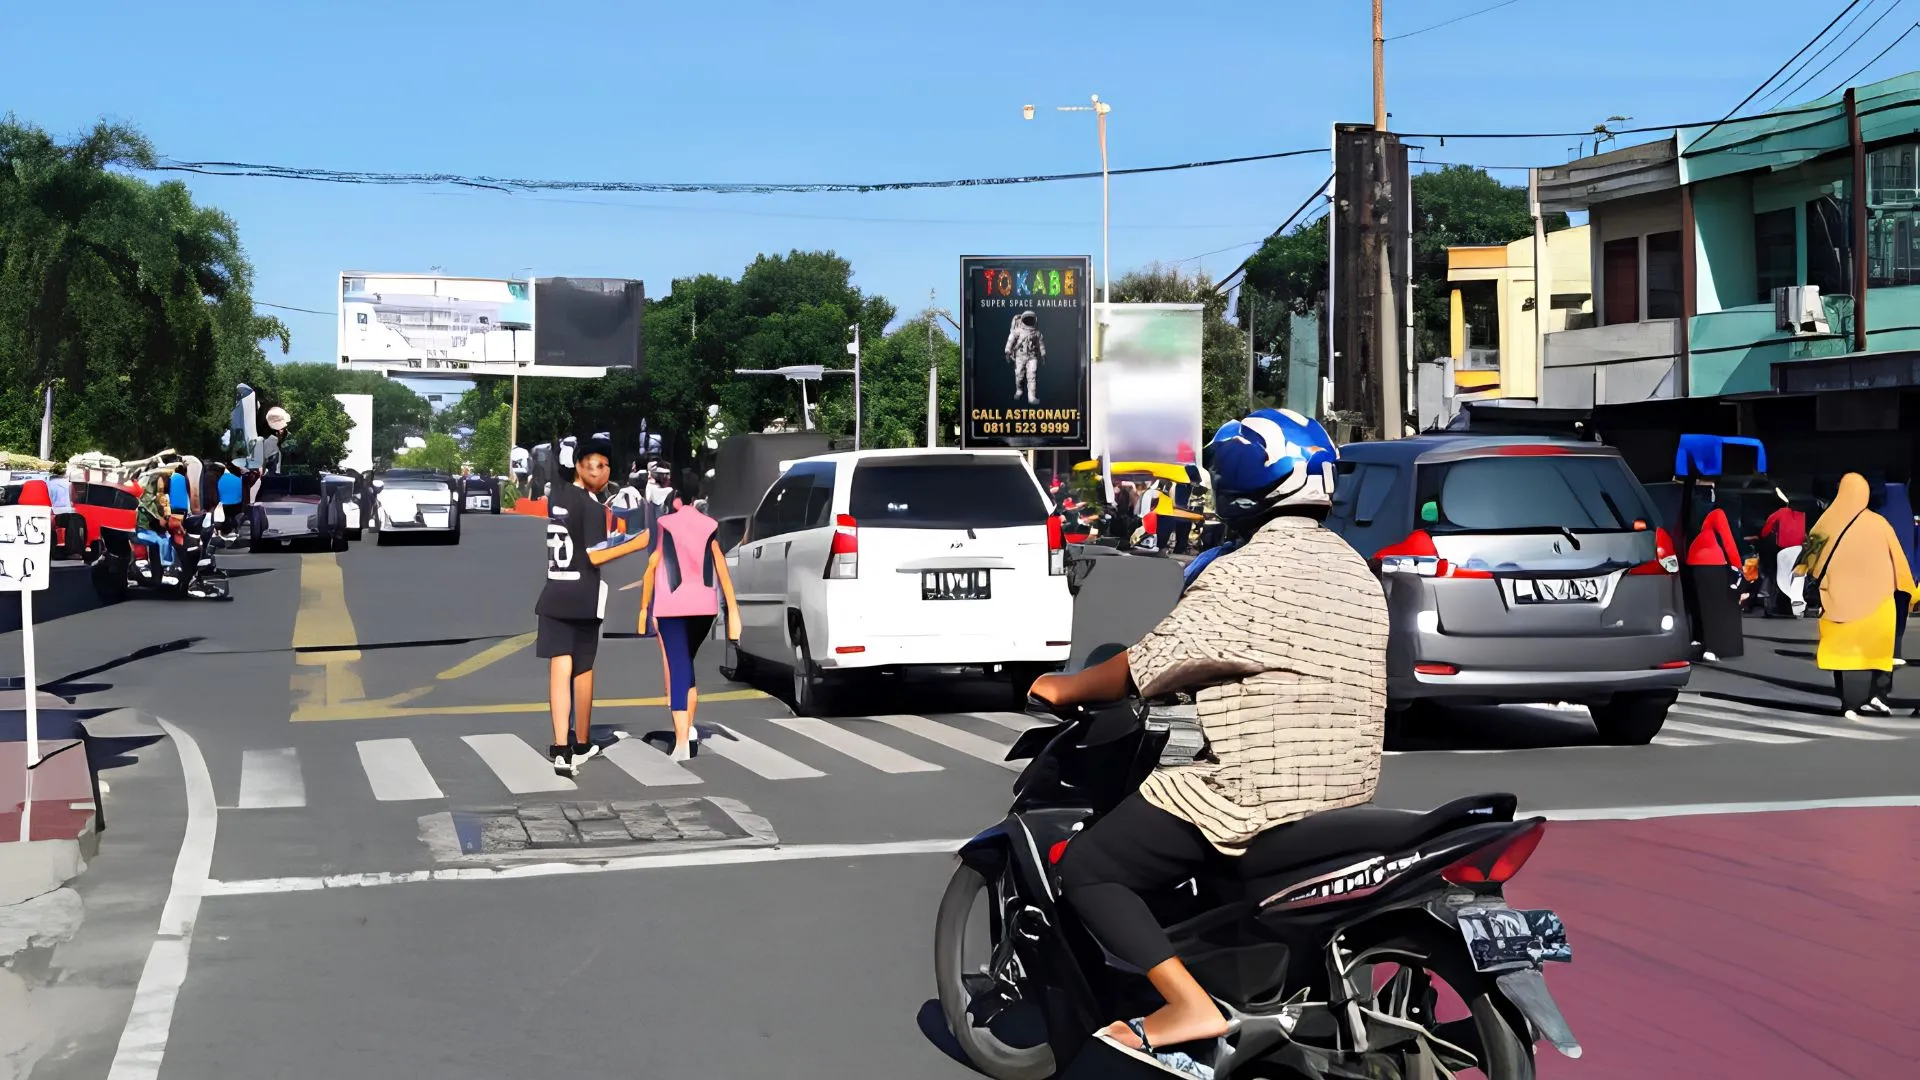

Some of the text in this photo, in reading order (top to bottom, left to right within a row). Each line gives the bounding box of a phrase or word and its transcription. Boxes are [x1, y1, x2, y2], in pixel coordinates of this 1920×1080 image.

[984, 269, 1075, 296] TOKABE
[980, 299, 1077, 308] SUPER SPACE AVAILABLE
[972, 409, 1080, 420] CALL ASTRONAUT:
[983, 422, 1070, 433] 0811 523 9999
